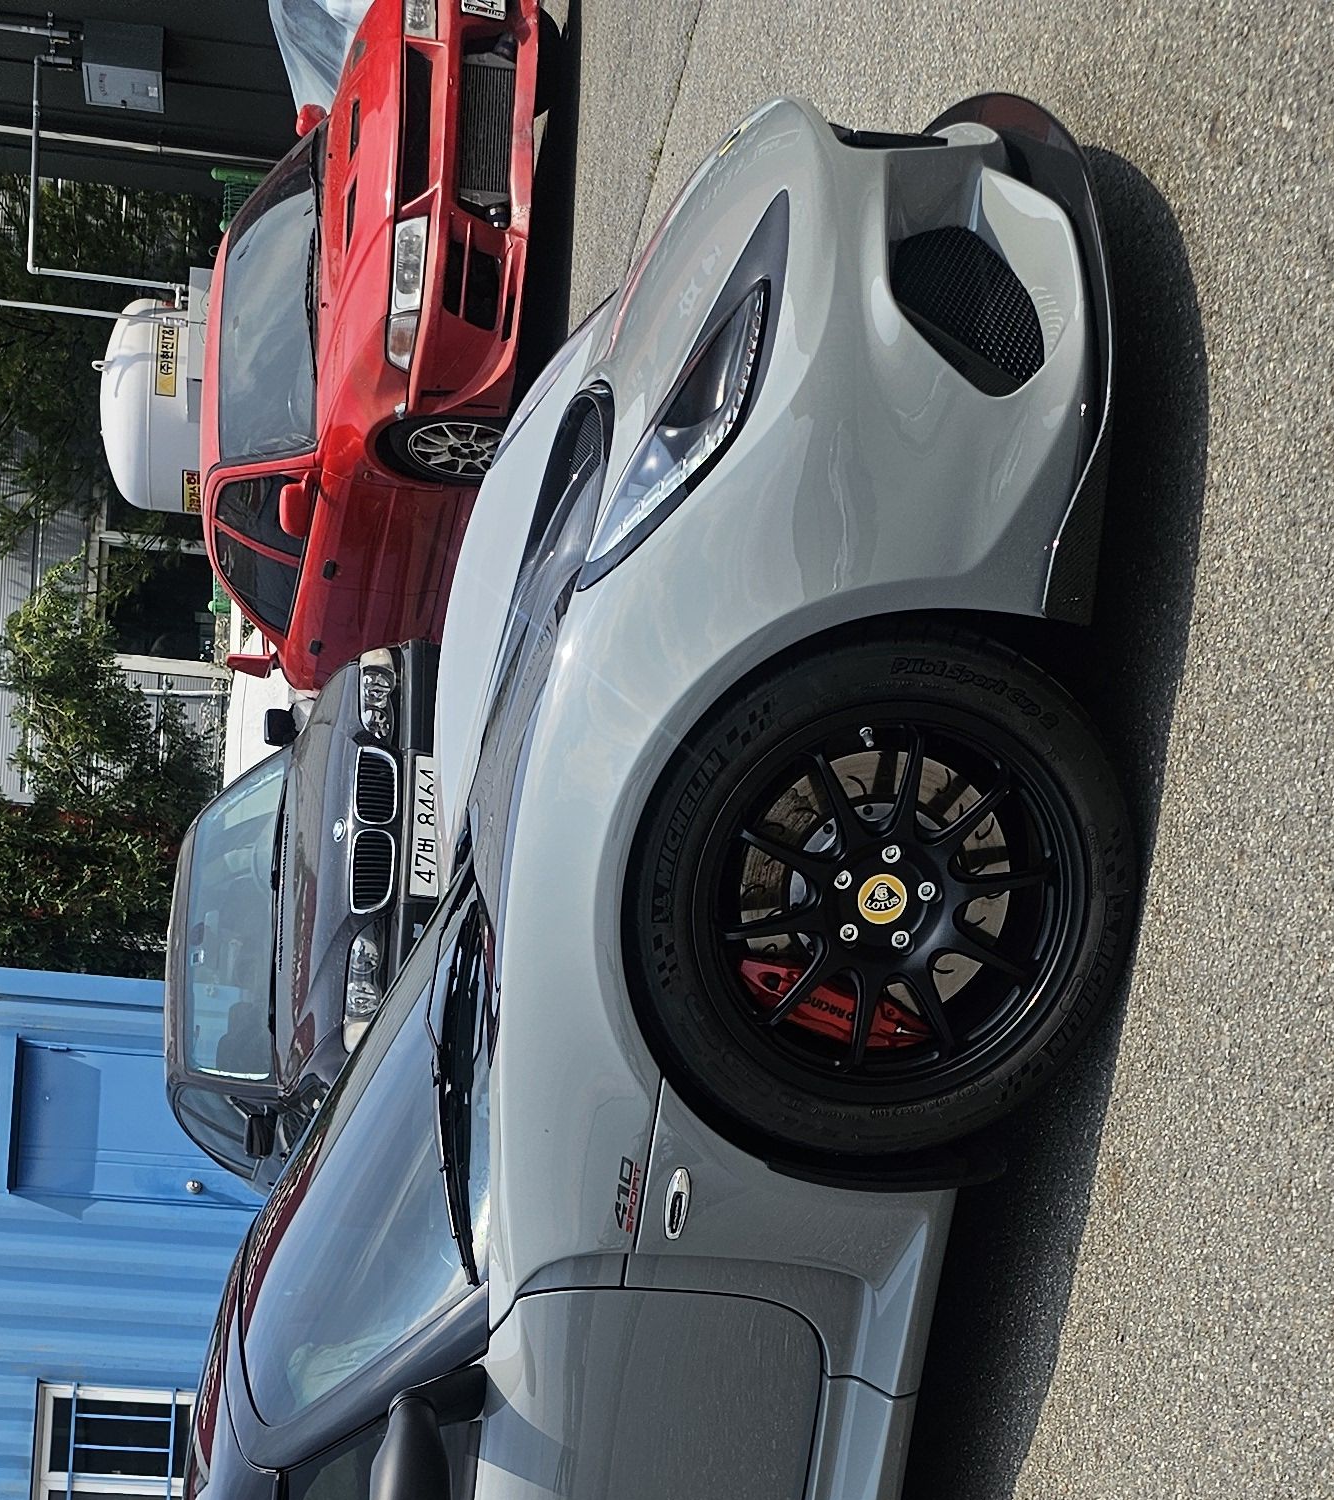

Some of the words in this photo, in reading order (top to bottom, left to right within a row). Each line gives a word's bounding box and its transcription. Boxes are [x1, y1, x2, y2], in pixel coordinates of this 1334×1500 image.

[158, 325, 176, 376] (주)현진T&
[890, 656, 947, 676] Pilot
[944, 663, 1008, 695] Sport
[1006, 687, 1041, 717] Cup
[654, 747, 724, 889] MICHELIN
[414, 837, 436, 884] 47버
[866, 895, 900, 910] LOTUS
[614, 1155, 634, 1230] 410
[625, 1161, 641, 1234] SPORT
